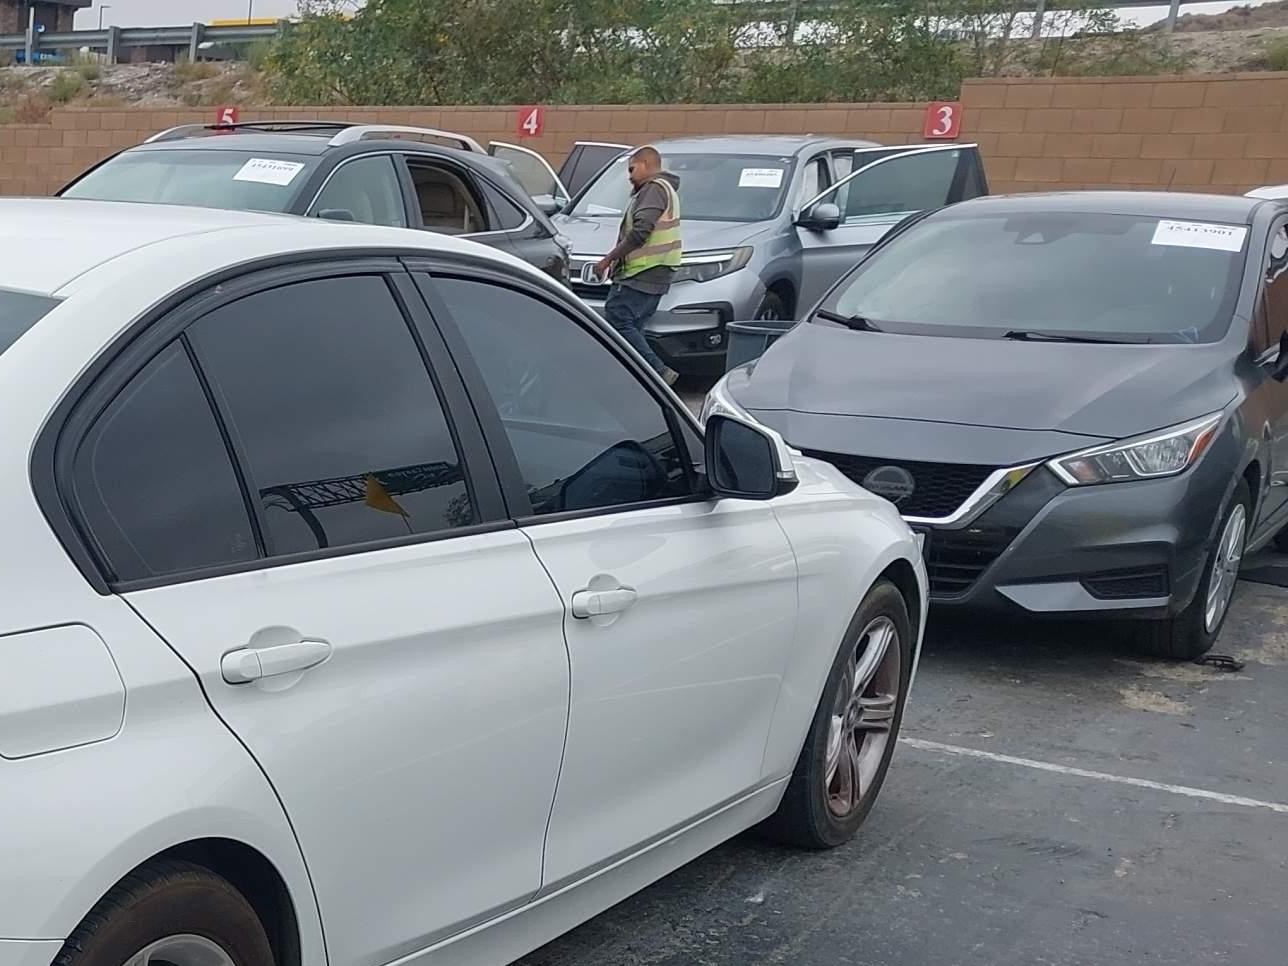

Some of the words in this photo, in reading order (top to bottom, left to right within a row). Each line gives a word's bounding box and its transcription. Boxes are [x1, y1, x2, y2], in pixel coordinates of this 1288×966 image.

[222, 108, 234, 125] 5
[523, 109, 538, 134] 4
[933, 106, 953, 135] 3
